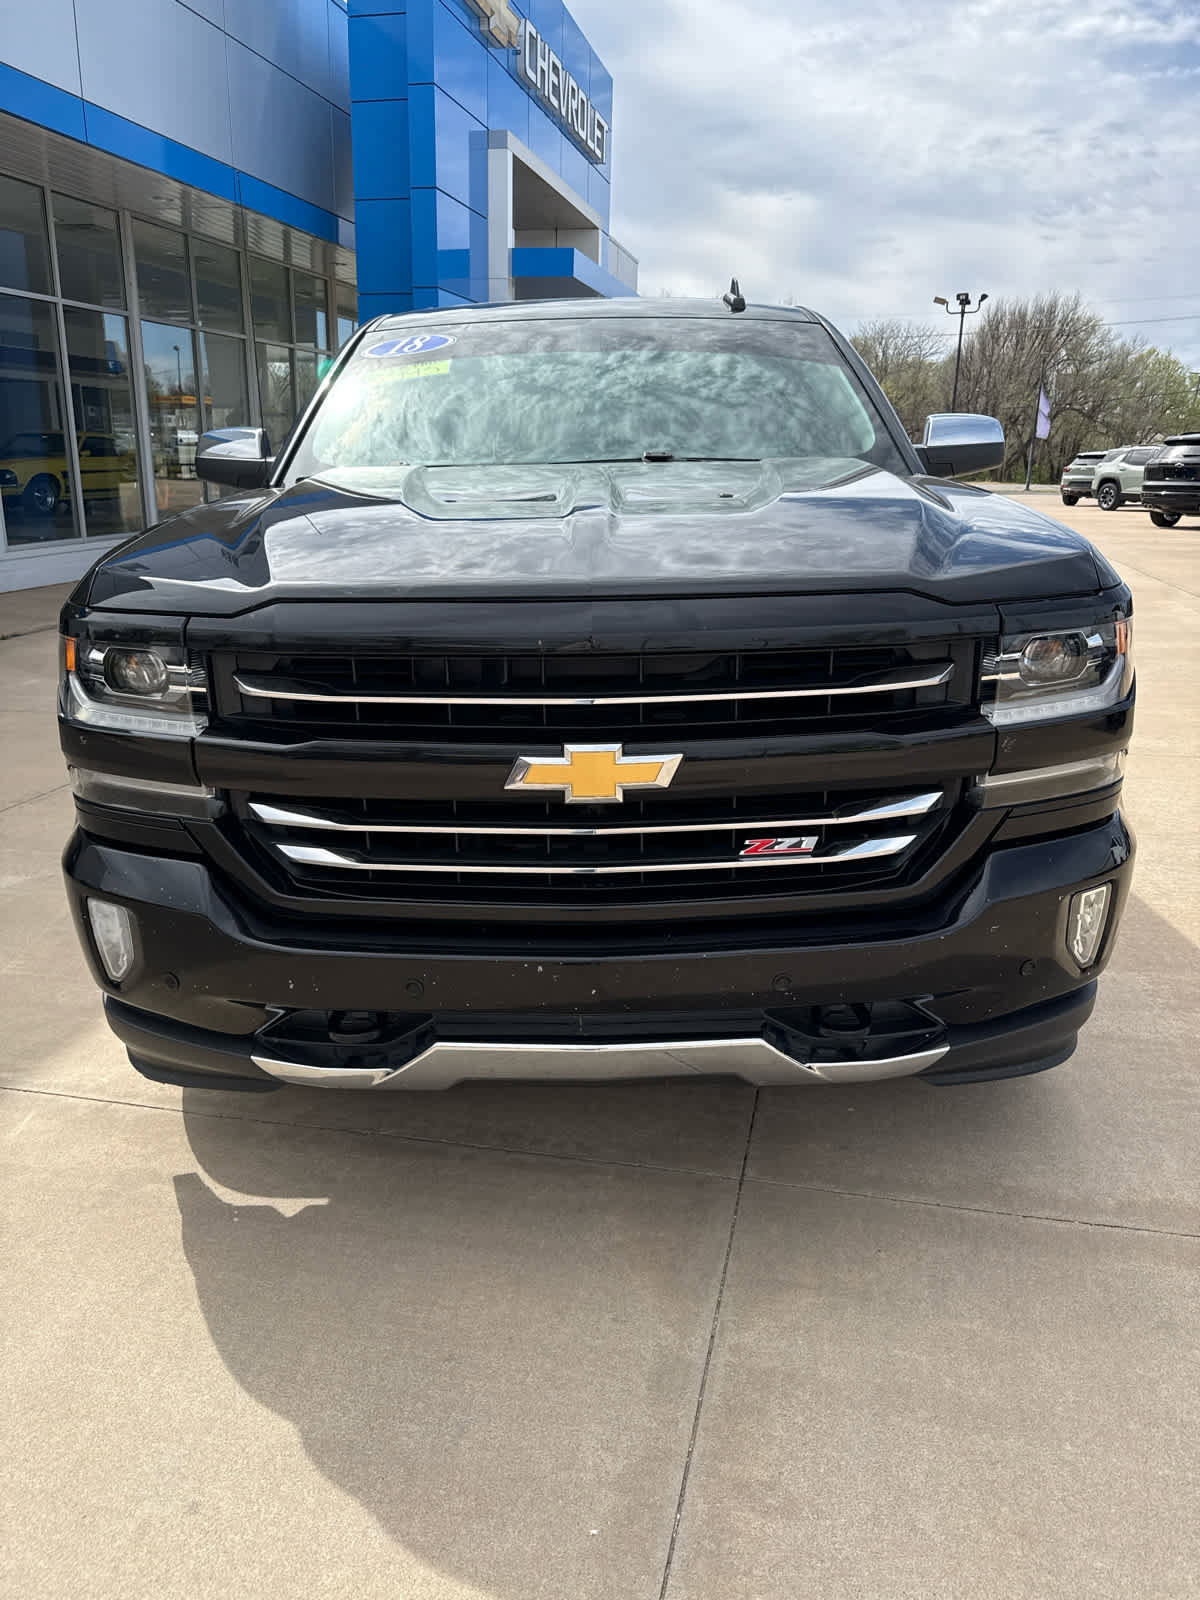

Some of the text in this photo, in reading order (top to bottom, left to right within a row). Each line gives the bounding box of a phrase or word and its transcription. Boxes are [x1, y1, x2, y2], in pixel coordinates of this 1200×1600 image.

[521, 18, 609, 164] CHEVROLET
[386, 335, 432, 355] 18
[739, 836, 819, 856] Z71
